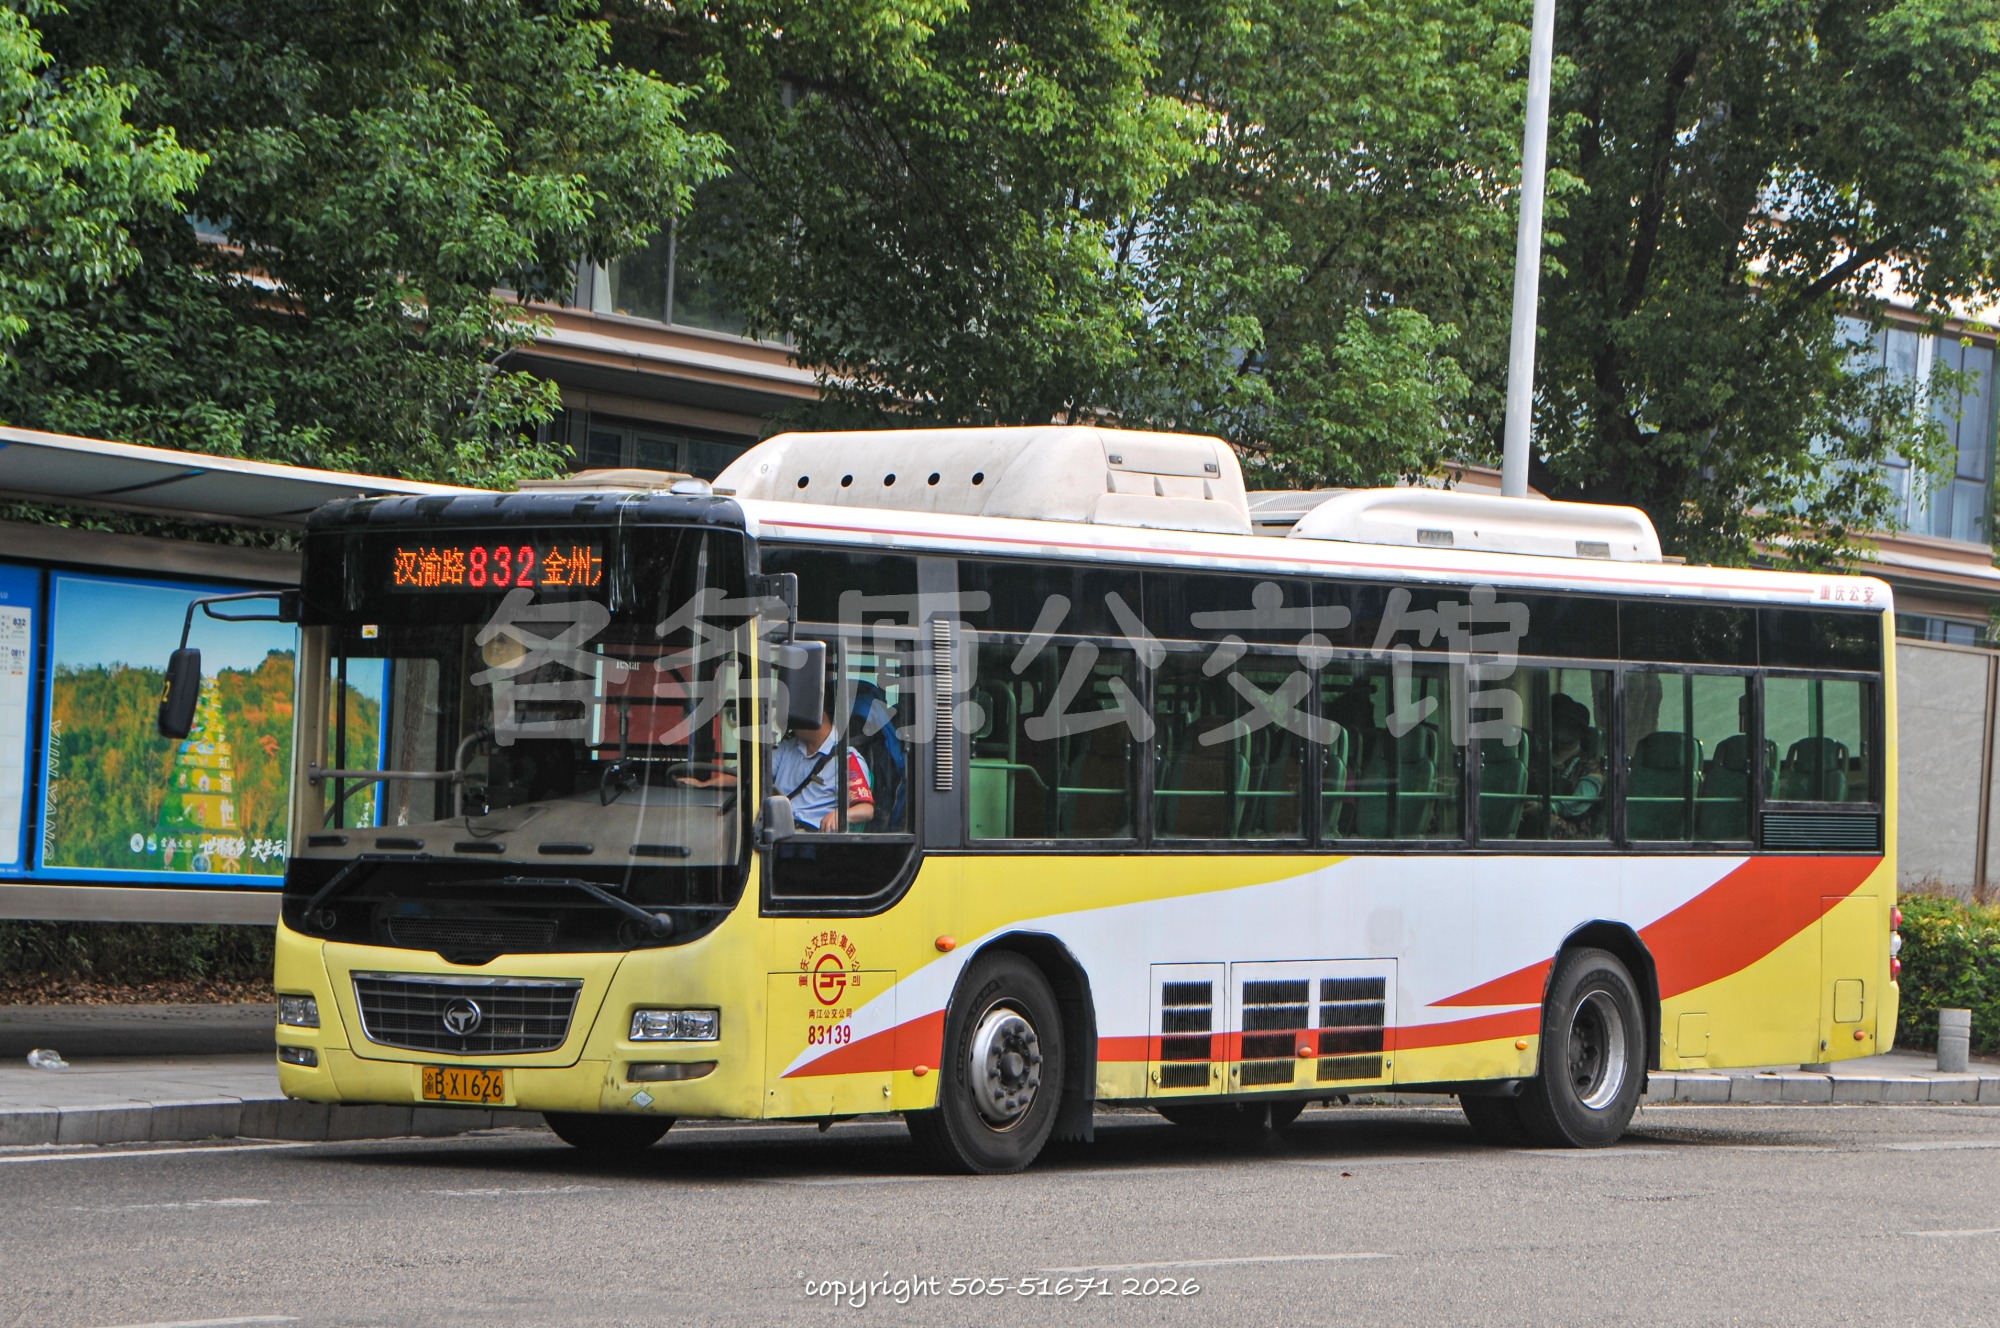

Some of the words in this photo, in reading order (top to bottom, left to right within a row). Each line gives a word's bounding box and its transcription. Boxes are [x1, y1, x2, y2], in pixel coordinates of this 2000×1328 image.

[393, 547, 467, 587] 汉渝路
[468, 546, 535, 587] 832
[1820, 584, 1875, 603] 重庆公交
[250, 838, 287, 863] 天生云
[808, 1008, 853, 1019] 两江公交公司
[808, 1025, 851, 1045] 83139
